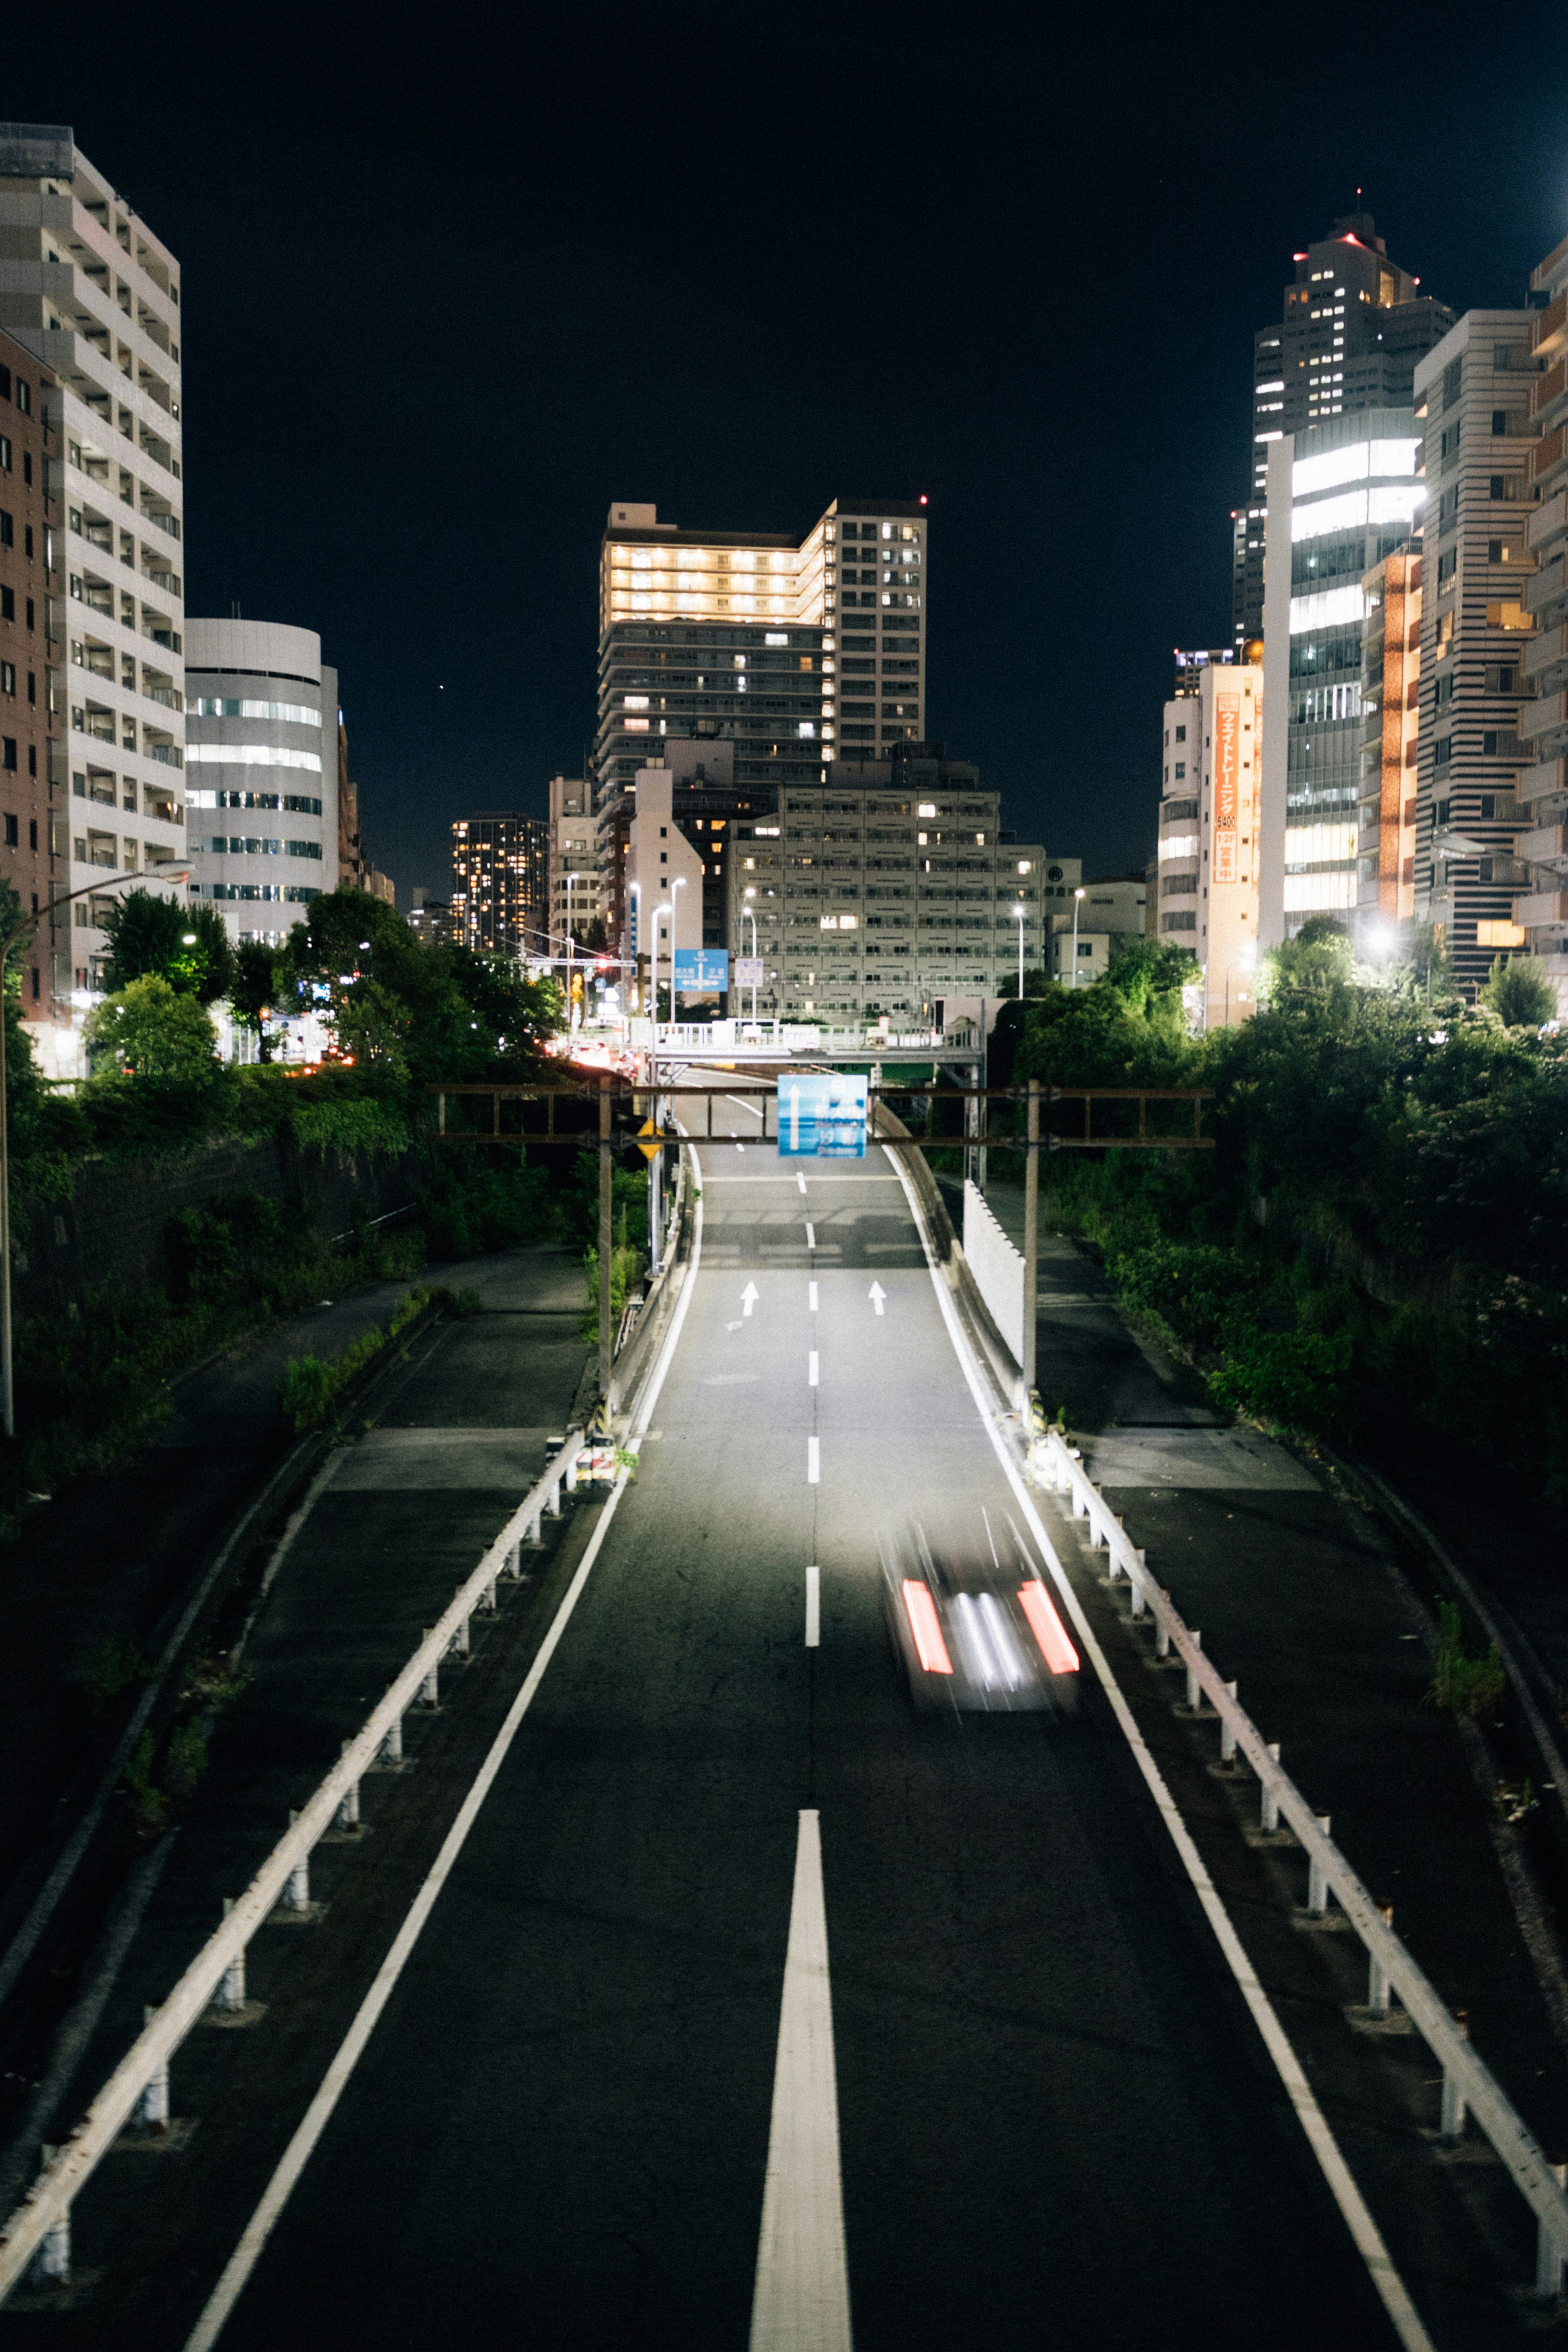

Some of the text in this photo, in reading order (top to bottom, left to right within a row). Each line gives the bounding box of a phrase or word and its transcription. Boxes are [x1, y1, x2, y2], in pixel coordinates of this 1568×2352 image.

[1221, 712, 1235, 815] ウエイトトレーニング
[1218, 816, 1235, 827] 5400
[1220, 846, 1231, 879] 営業中
